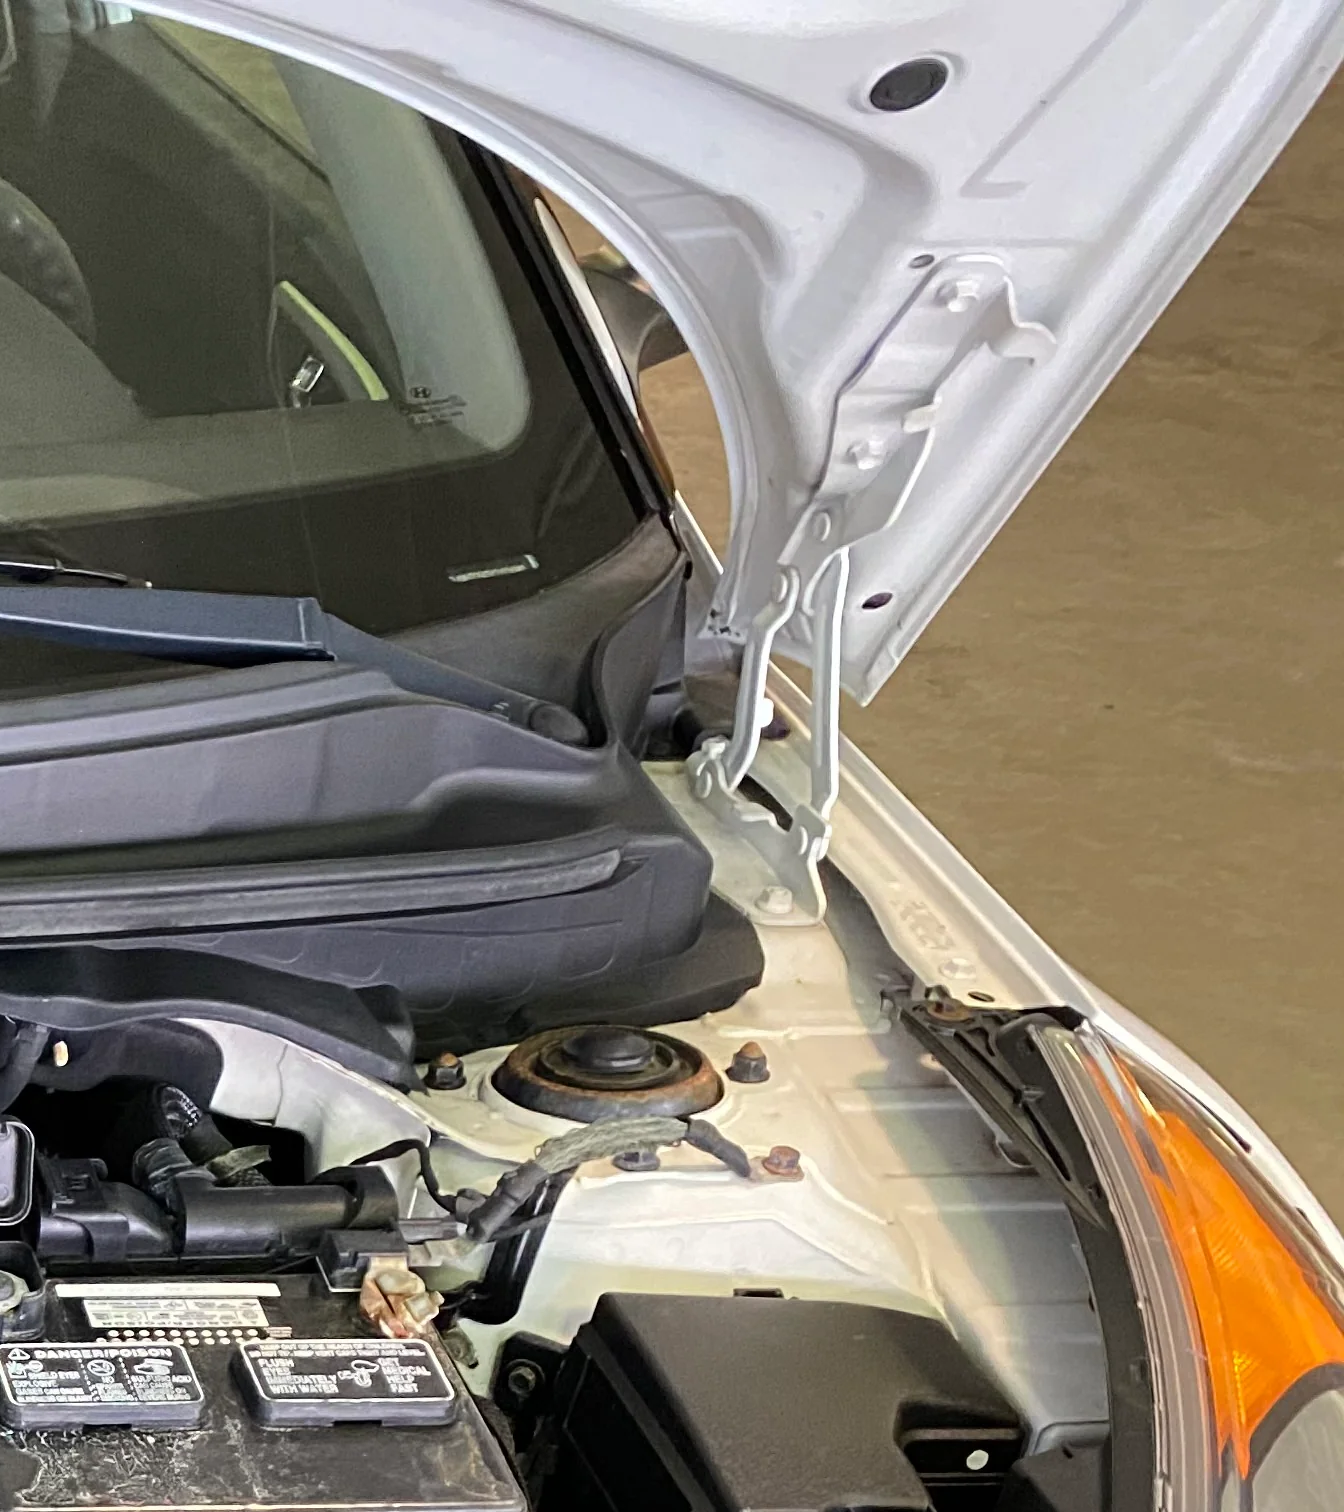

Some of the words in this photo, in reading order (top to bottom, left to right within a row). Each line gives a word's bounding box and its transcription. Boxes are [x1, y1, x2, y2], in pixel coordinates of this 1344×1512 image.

[34, 1348, 172, 1359] DANGER/POISON
[258, 1358, 294, 1367] FLUSH
[378, 1358, 399, 1366] GET
[262, 1367, 291, 1376] EYES
[382, 1366, 431, 1376] MEDICAL
[266, 1375, 336, 1384] IMMEDIATELY
[387, 1375, 414, 1383] HELP
[270, 1384, 298, 1393] WITH
[299, 1384, 339, 1393] WATER
[390, 1383, 418, 1392] FAST
